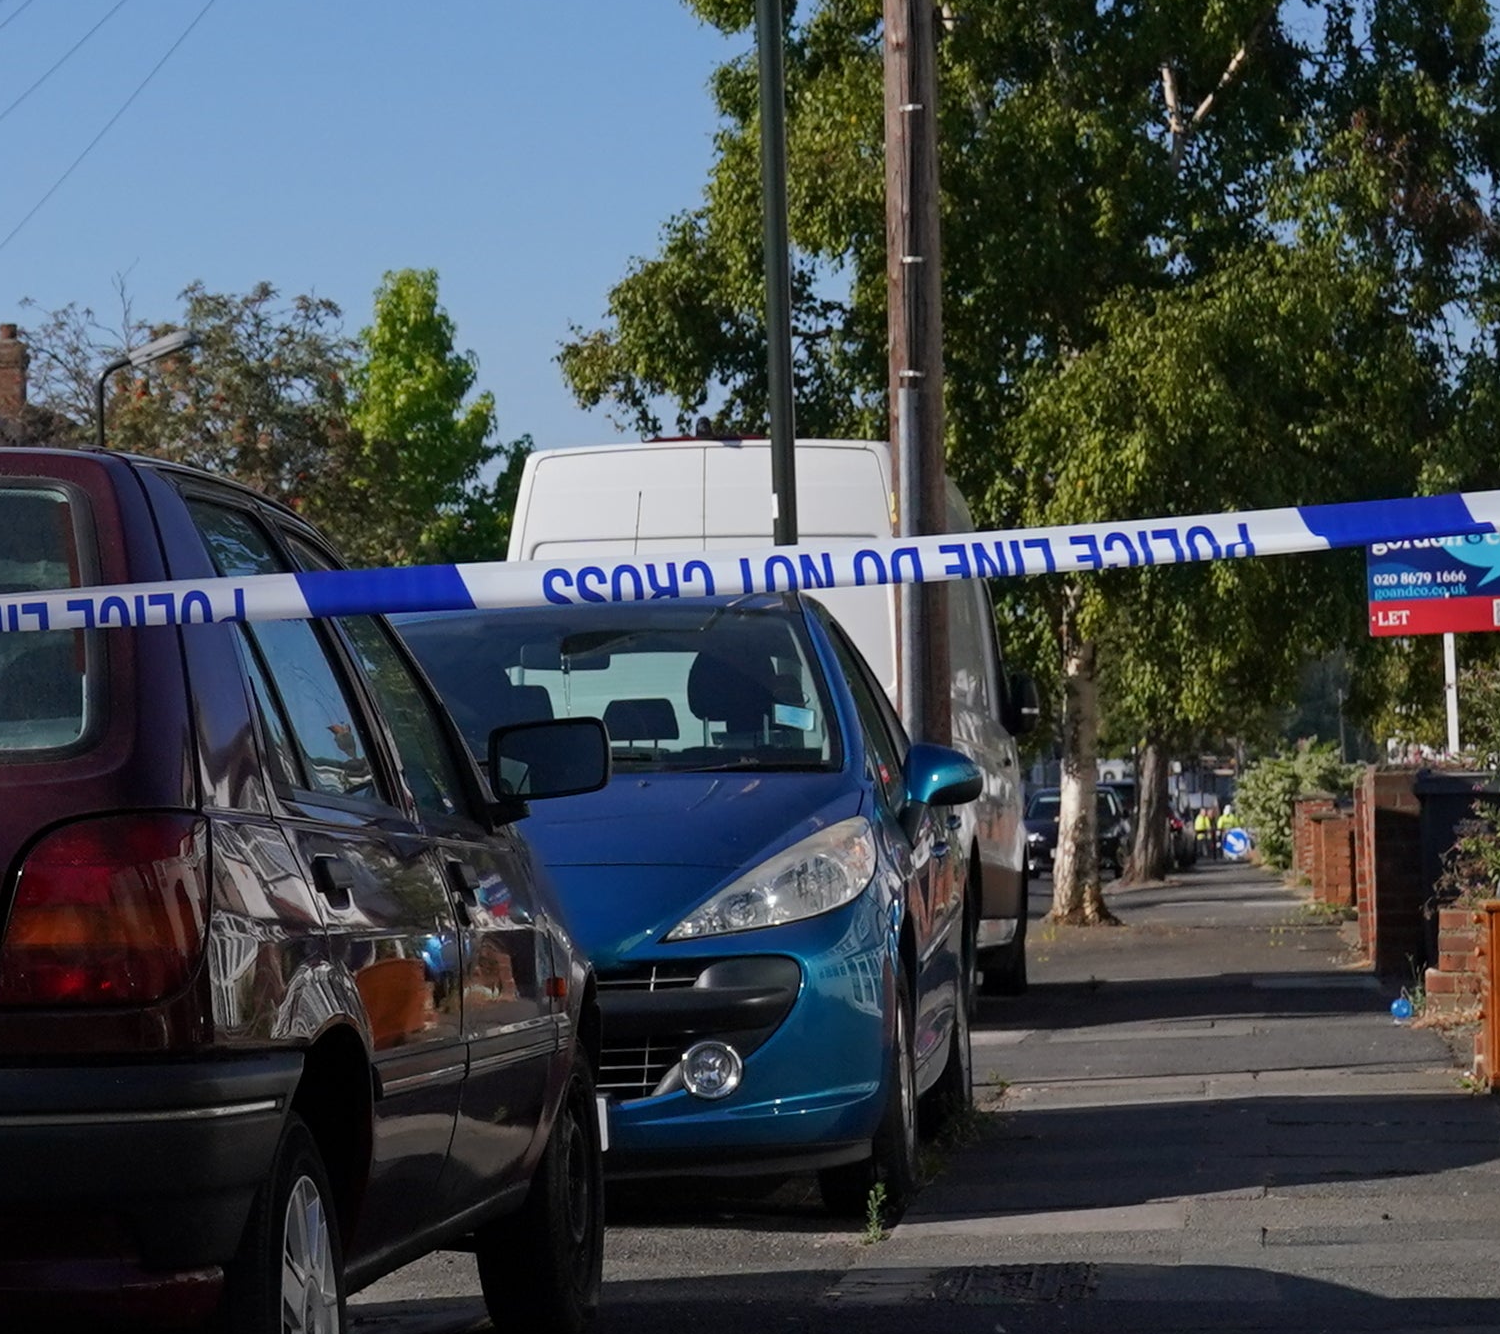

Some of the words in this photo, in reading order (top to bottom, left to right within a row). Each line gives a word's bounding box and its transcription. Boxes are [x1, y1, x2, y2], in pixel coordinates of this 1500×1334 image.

[939, 537, 1056, 579] LINE
[1069, 523, 1256, 568] POLICE
[1373, 573, 1398, 586] 020
[1400, 571, 1432, 585] 8679
[1435, 569, 1467, 583] 1666
[1378, 610, 1410, 626] LET
